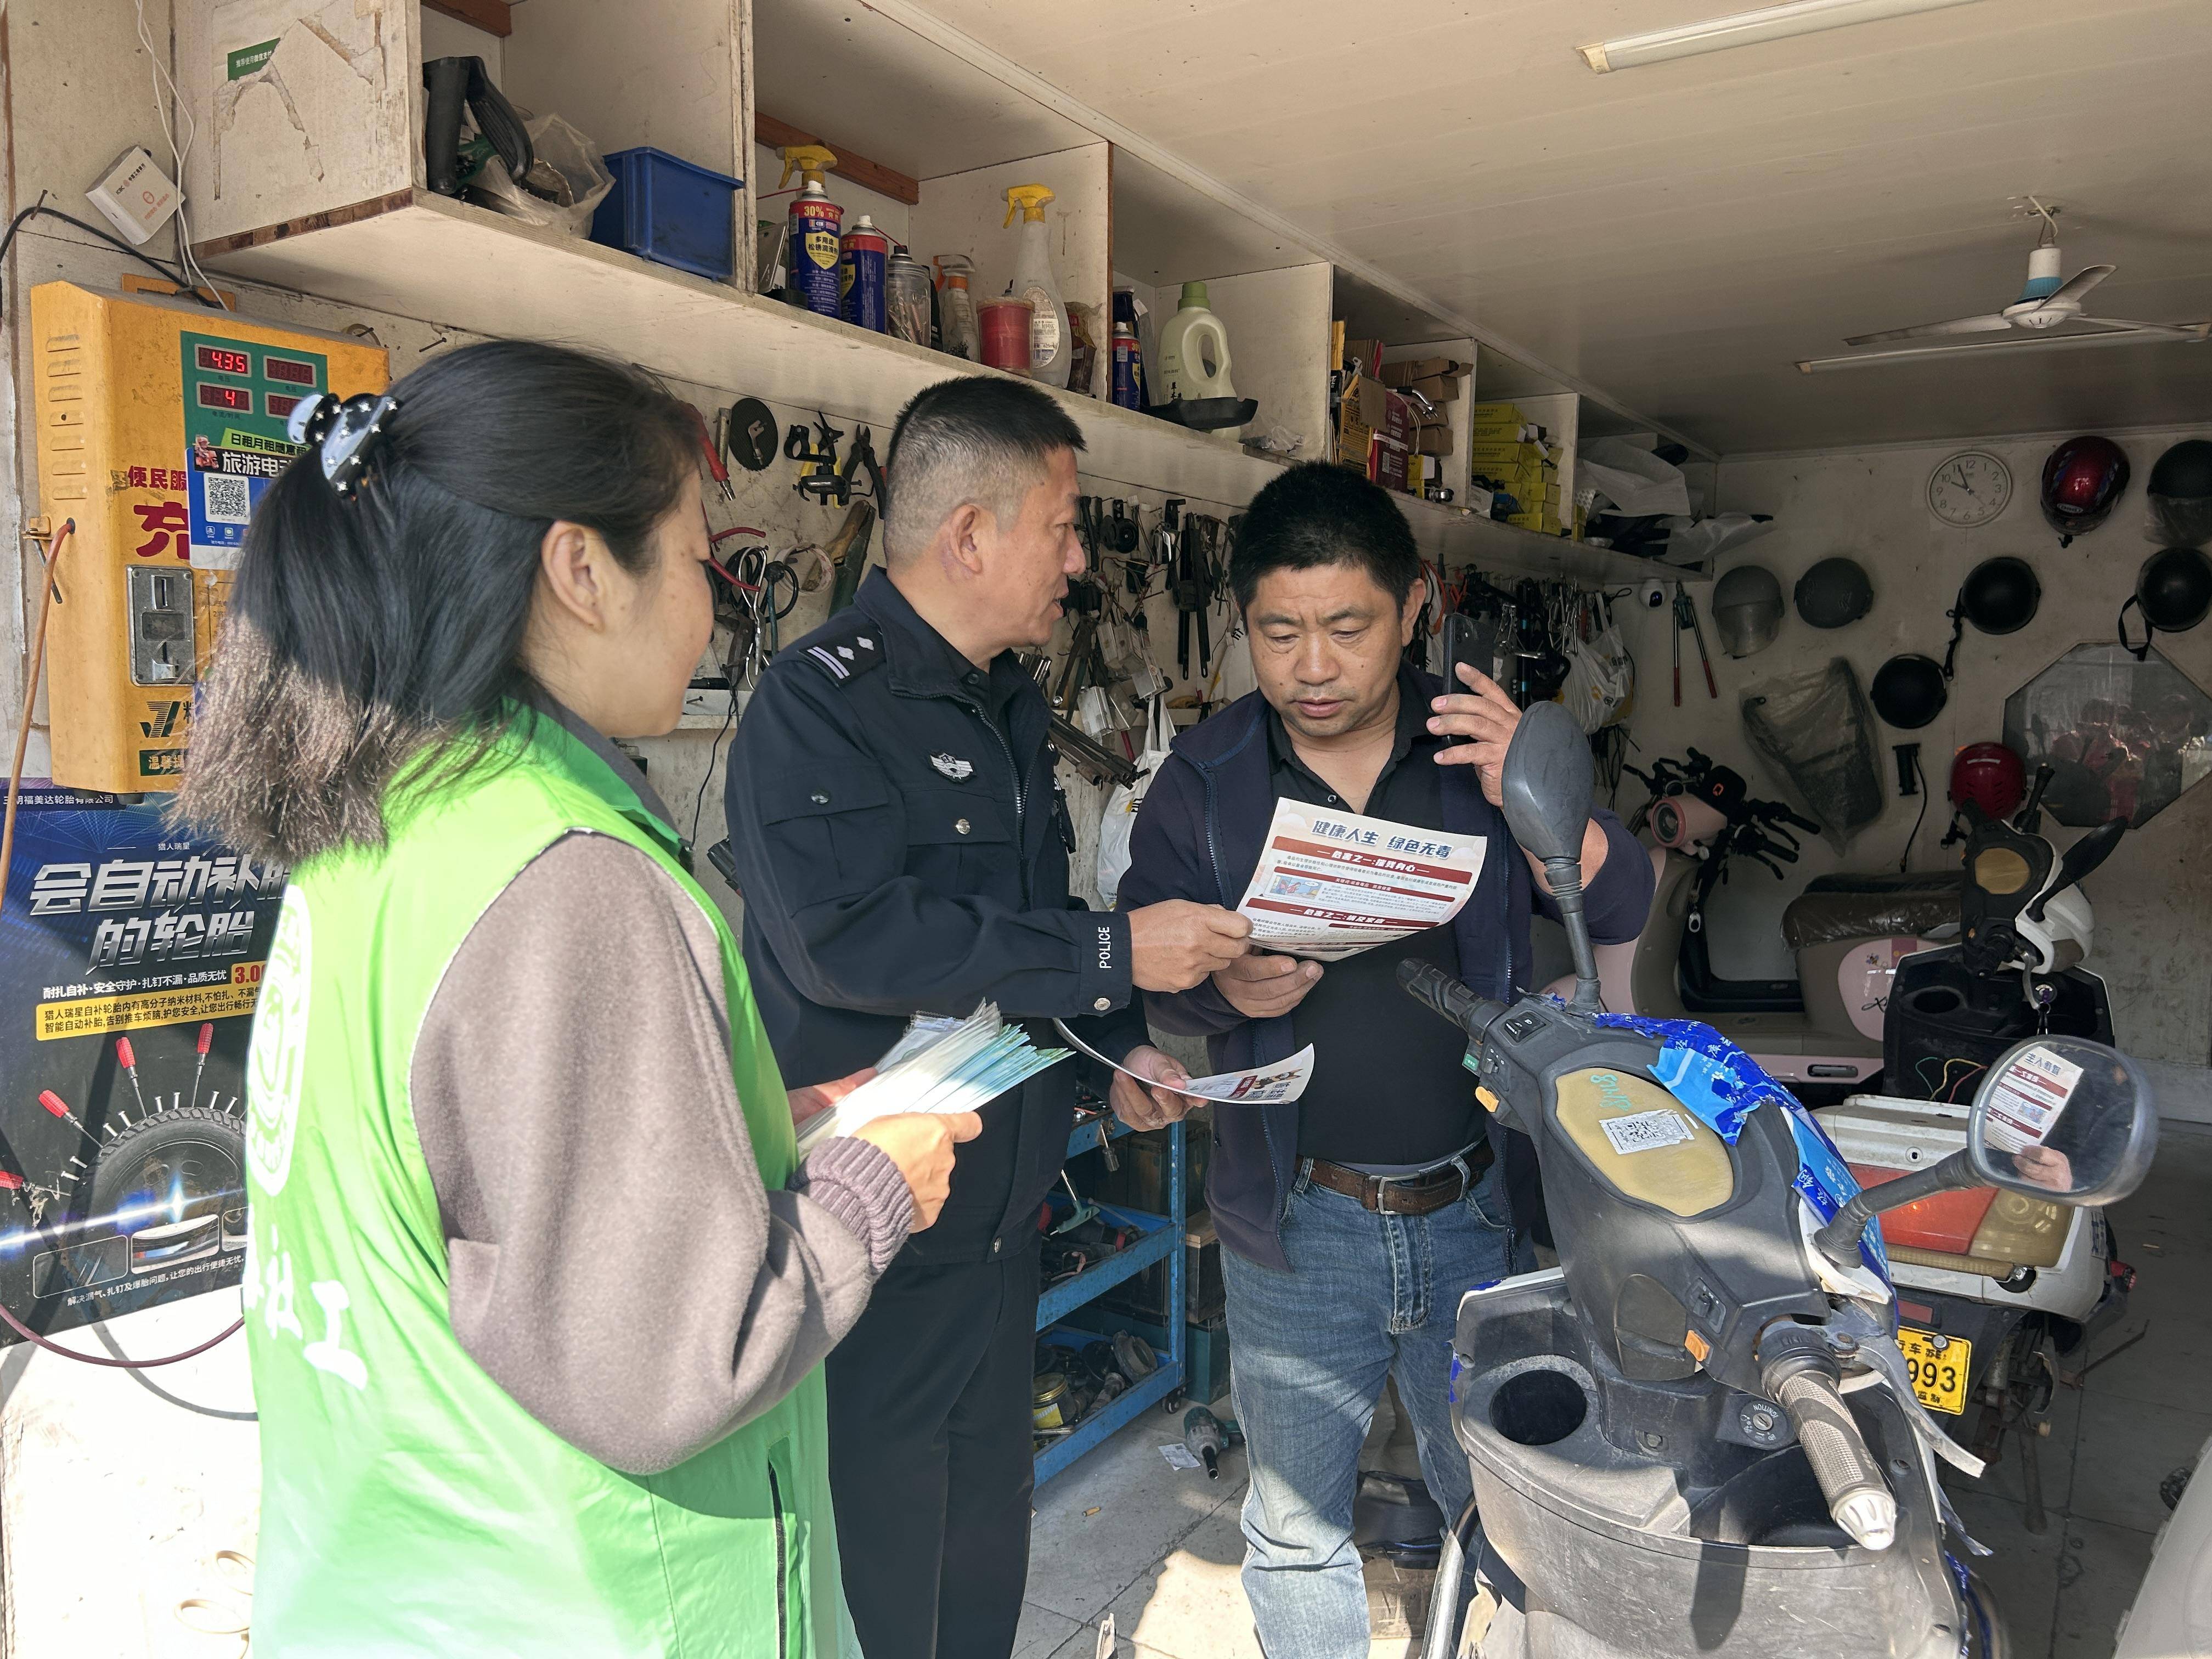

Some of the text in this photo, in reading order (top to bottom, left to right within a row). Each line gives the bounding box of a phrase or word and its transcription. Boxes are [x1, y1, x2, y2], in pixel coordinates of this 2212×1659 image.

[804, 206, 825, 218] 30%
[212, 351, 246, 373] 4.35
[225, 390, 236, 406] 4
[1942, 474, 1951, 483] 10
[1992, 472, 1999, 481] 2
[1937, 487, 1943, 495] 9
[1995, 484, 2001, 493] 3
[1989, 498, 1996, 506] 4
[1963, 511, 1971, 520] 6
[1978, 507, 1984, 516] 5
[1312, 820, 1453, 860] 健康人生 绿色无毒
[157, 842, 190, 851] 猎人瑞星
[86, 910, 255, 975] 的轮胎
[1098, 926, 1112, 970] POLICE
[1906, 1358, 1956, 1392] 993
[1753, 1403, 1779, 1419] IGNITION
